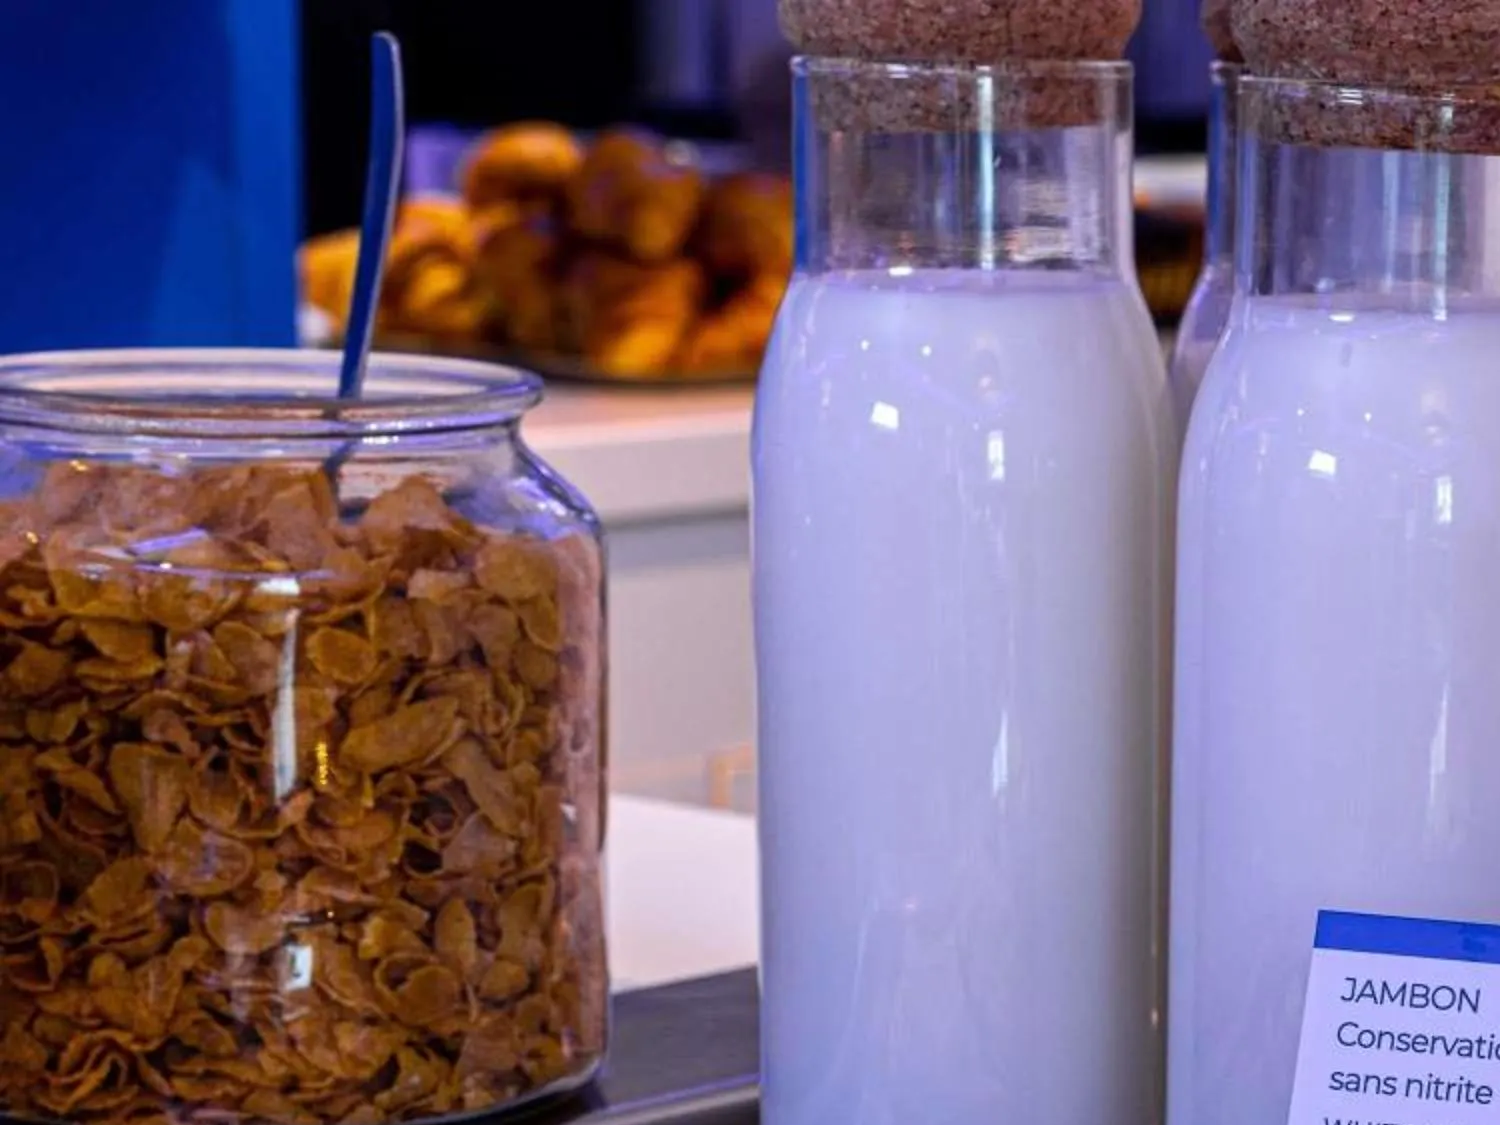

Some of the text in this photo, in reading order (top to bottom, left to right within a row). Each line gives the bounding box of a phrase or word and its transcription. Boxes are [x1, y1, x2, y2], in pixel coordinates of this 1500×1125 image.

[1339, 976, 1481, 1014] JAMBON
[1327, 1070, 1494, 1105] sans nitrite
